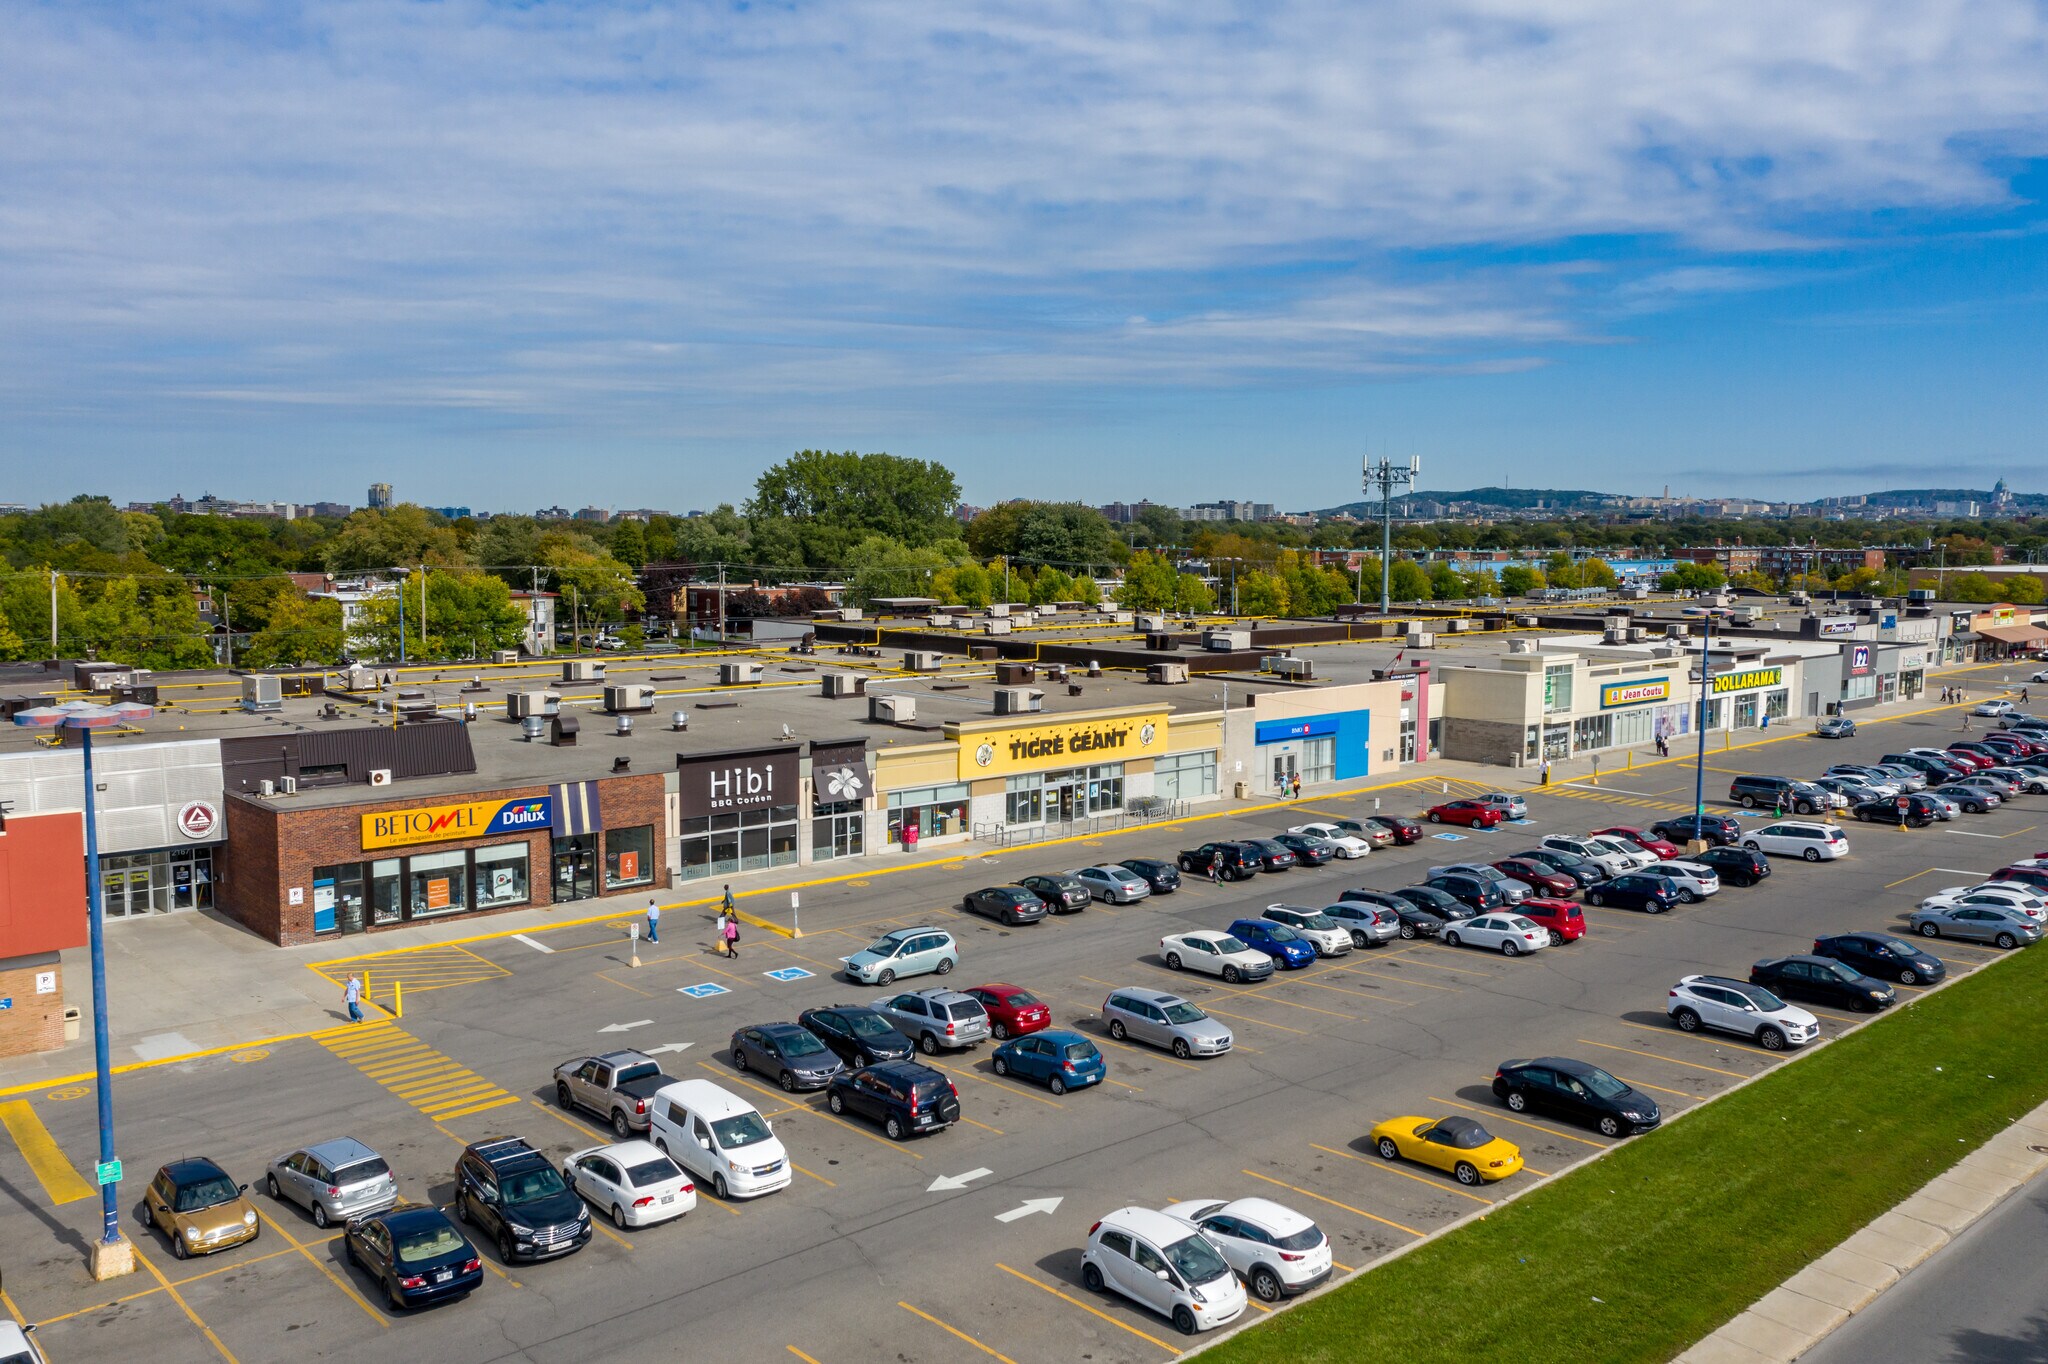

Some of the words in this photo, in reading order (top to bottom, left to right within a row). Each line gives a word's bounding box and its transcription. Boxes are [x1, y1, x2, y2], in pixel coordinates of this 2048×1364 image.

[1714, 671, 1775, 692] DOLLARAMA
[1624, 690, 1641, 699] Jean
[1642, 687, 1662, 697] Coutu
[1009, 738, 1064, 760] TIGRE
[1069, 730, 1128, 753] GÉANT
[710, 764, 773, 798] Hibi
[711, 799, 733, 808] BBQ
[737, 795, 772, 804] Coréen
[503, 810, 546, 825] Dulux
[409, 833, 433, 842] magasin
[442, 830, 467, 838] peinture
